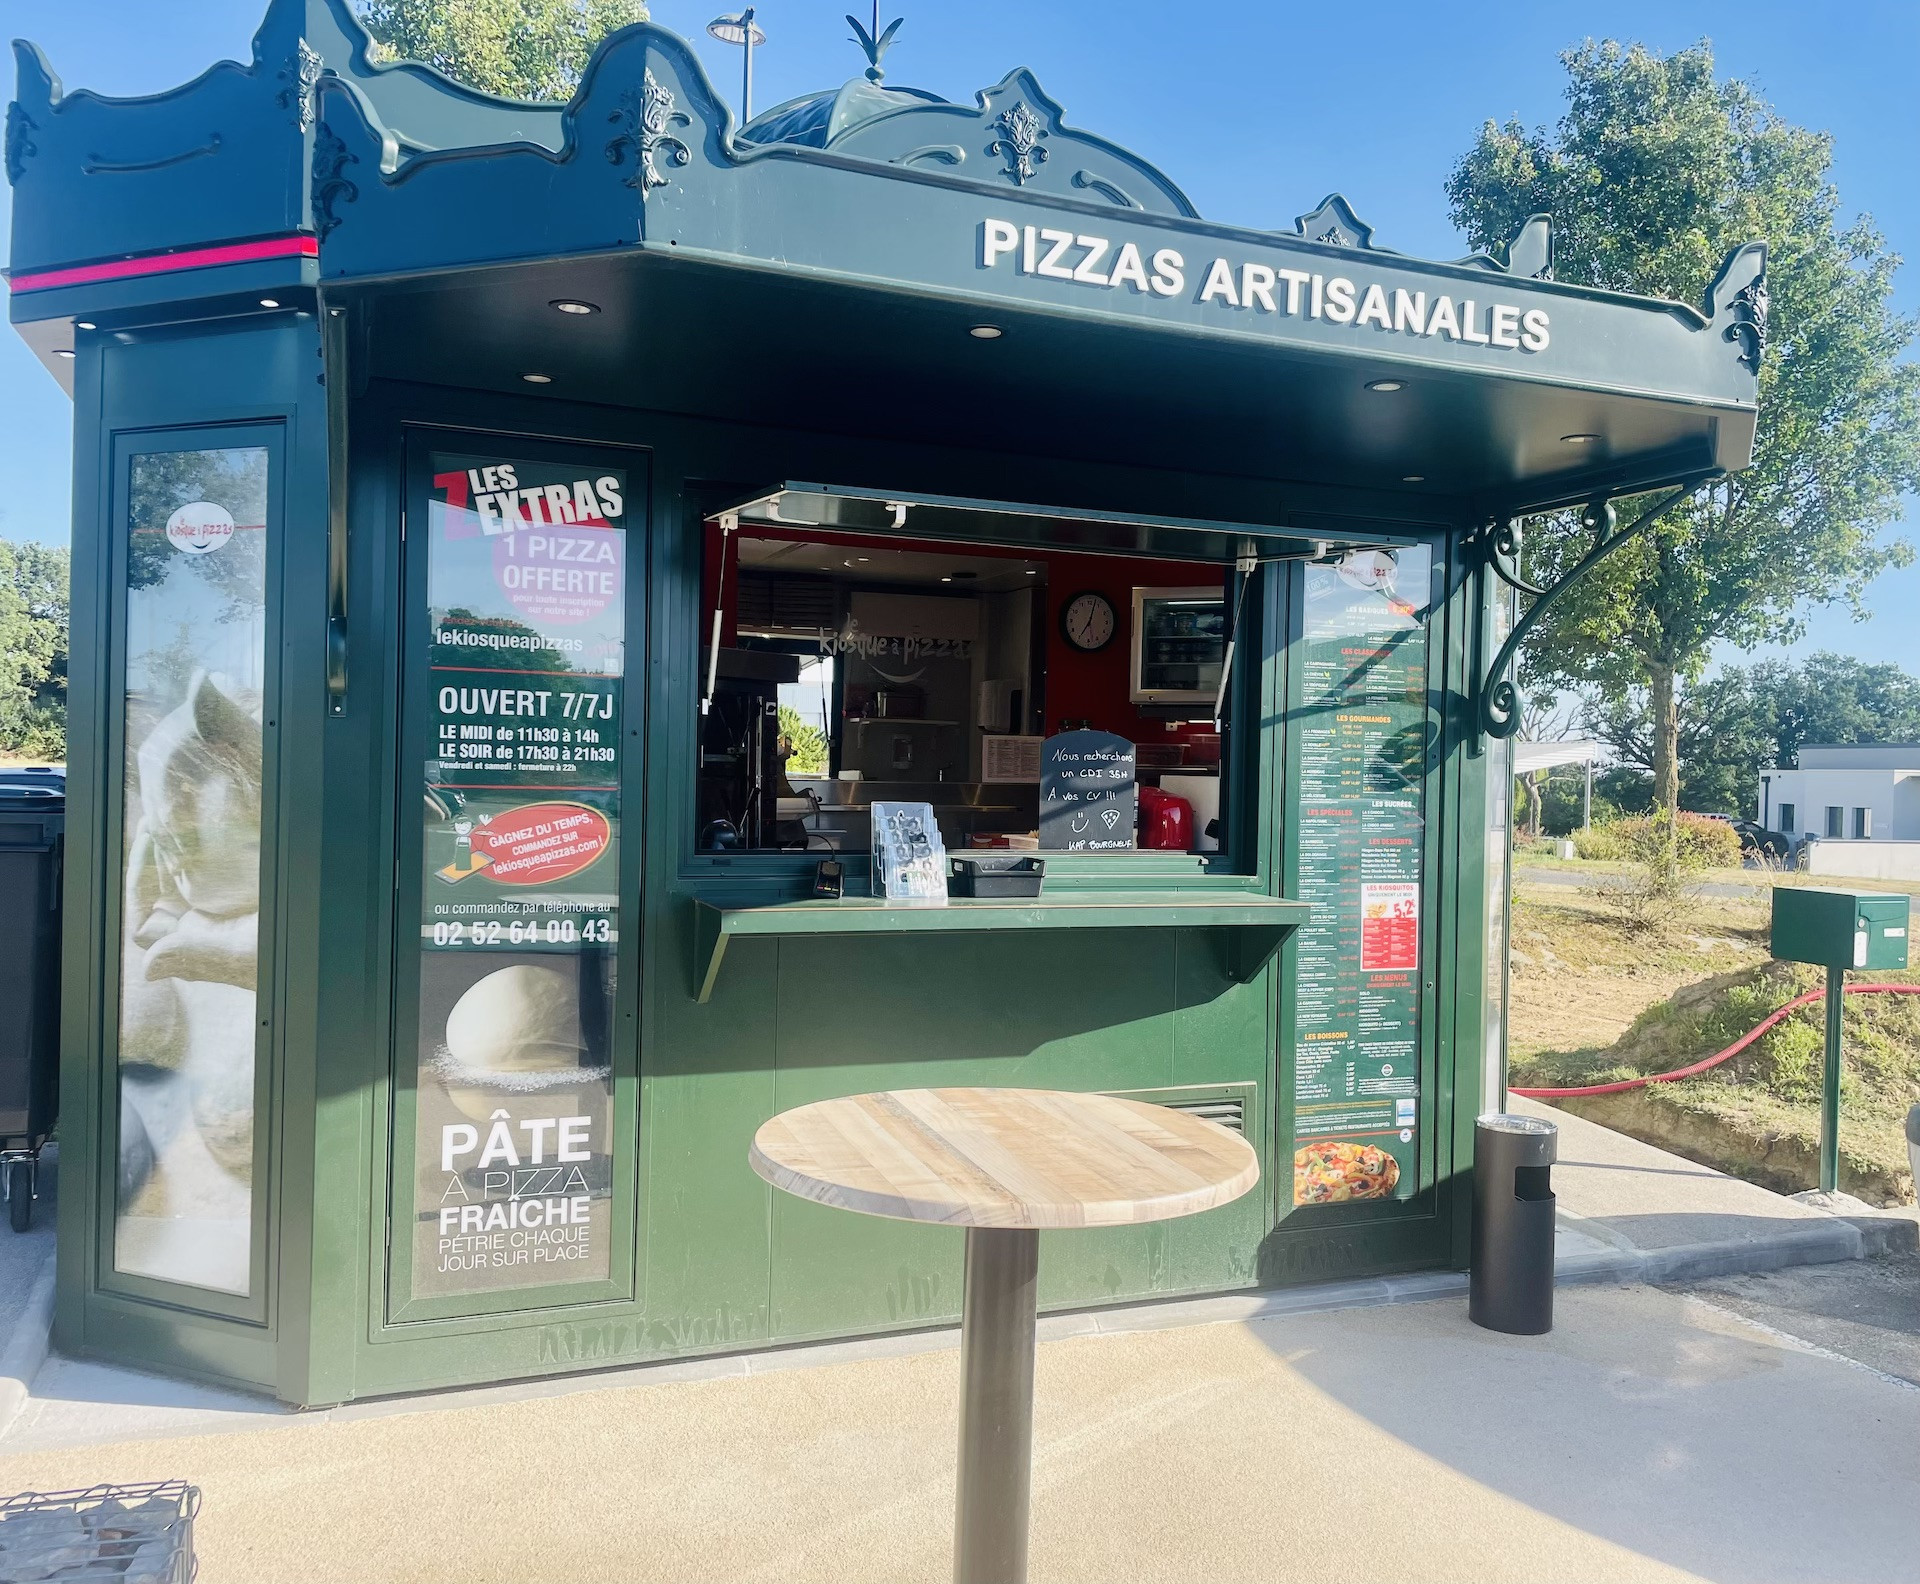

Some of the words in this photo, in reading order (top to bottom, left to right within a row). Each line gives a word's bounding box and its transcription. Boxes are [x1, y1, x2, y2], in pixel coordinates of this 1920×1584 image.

[983, 219, 1184, 296] PIZZAS
[1200, 258, 1550, 352] ARTISANALES
[467, 464, 518, 494] LES
[475, 476, 623, 536] EXTRAS
[503, 535, 515, 557] 1
[528, 535, 616, 564] PIZZA
[503, 565, 614, 595] OFFERTE
[513, 595, 533, 604] pour
[535, 595, 558, 605] toute
[560, 595, 604, 608] inscription
[528, 606, 544, 614] sur
[545, 606, 566, 616] notre
[568, 607, 584, 616] site
[847, 612, 859, 632] le
[436, 628, 583, 652] lekiosqueapizzas
[819, 627, 887, 660] kiosque
[892, 639, 900, 655] à
[438, 687, 552, 717] OUVERT
[560, 692, 613, 720] 7/7J
[1349, 715, 1391, 723] GOURMANDES
[439, 725, 456, 740] LE
[460, 725, 492, 740] MIDI
[496, 727, 513, 741] de
[518, 728, 559, 742] 11h30
[563, 728, 571, 743] à
[575, 729, 599, 743] 14h
[439, 743, 455, 758] LE
[460, 744, 492, 759] SOIR
[496, 744, 513, 759] de
[517, 746, 558, 761] 17h30
[562, 746, 570, 761] à
[574, 747, 615, 762] 21h30
[1052, 747, 1079, 762] Nous
[1084, 750, 1133, 762] recherchons
[439, 761, 473, 770] Vendredi
[475, 762, 483, 770] et
[484, 762, 512, 771] samedi
[518, 763, 555, 771] fermeture
[562, 764, 577, 772] 22h
[1080, 769, 1103, 778] CDI
[1048, 787, 1056, 801] A
[1063, 792, 1078, 801] vos
[1087, 791, 1101, 800] CV
[489, 829, 534, 848] GAGNEZ
[536, 822, 551, 836] DU
[553, 813, 593, 832] TEMPS,
[512, 836, 561, 855] COMMANDEZ
[562, 831, 579, 843] SUR
[1089, 840, 1133, 850] BOURGNEUF
[492, 841, 598, 875] lekiosqueapizzas.com
[435, 904, 449, 914] ou
[453, 901, 519, 914] commandez
[522, 903, 540, 915] par
[543, 901, 595, 915] téléphone
[597, 902, 610, 912] au
[434, 921, 463, 946] 02
[472, 921, 501, 945] 52
[509, 920, 538, 944] 64
[546, 920, 574, 944] 00
[581, 919, 610, 943] 43
[1317, 1031, 1348, 1039] BOISSONS
[441, 1108, 592, 1171] PÂTE
[440, 1168, 469, 1204] À
[484, 1166, 589, 1199] PIZZA
[439, 1194, 591, 1236] FRAÎCHE
[438, 1234, 505, 1254] PÉTRIE
[510, 1226, 590, 1248] CHAQUE
[438, 1253, 487, 1273] JOUR
[492, 1250, 528, 1268] SUR
[533, 1244, 589, 1263] PLACE
